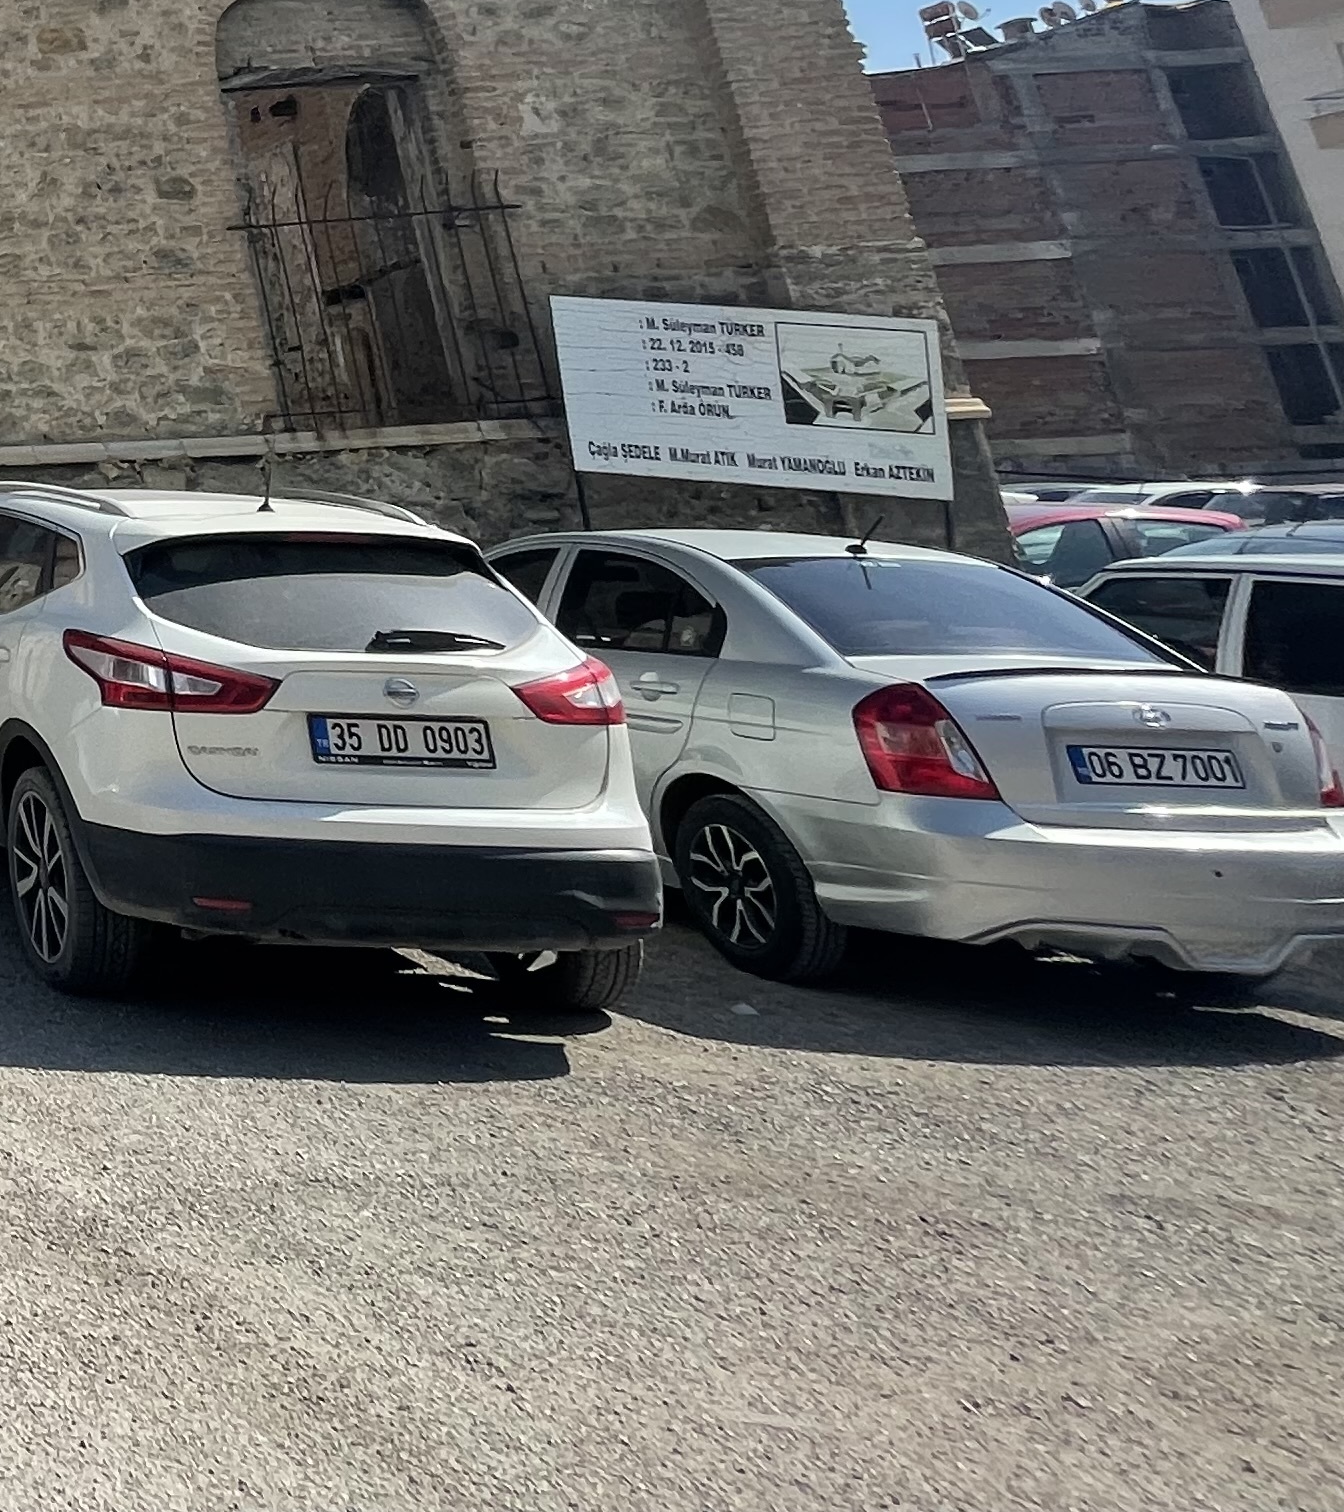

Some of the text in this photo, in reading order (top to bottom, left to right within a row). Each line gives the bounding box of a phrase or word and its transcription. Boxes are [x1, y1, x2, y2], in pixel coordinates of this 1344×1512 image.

[652, 358, 673, 372] 233
[682, 360, 690, 373] 2
[331, 722, 485, 756] 35 DD 0903
[1087, 751, 1241, 784] 06 BZ 7001
